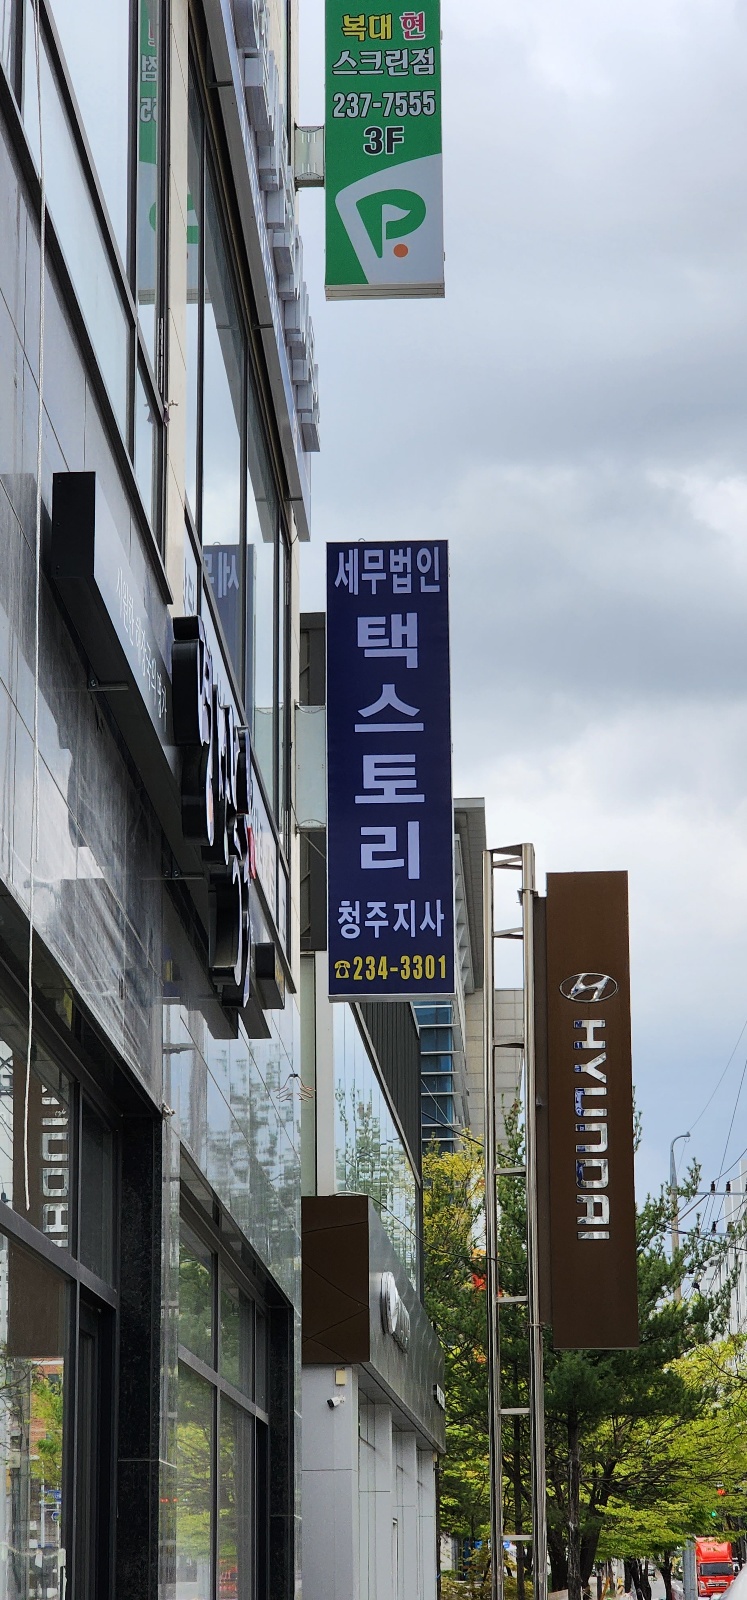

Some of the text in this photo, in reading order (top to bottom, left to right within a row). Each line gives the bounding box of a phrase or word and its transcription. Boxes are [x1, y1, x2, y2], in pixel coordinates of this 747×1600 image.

[342, 11, 426, 41] 복대 현
[332, 47, 435, 76] 스크린점
[332, 90, 436, 118] 237-7555
[363, 126, 404, 155] 3F
[334, 547, 440, 595] 세무법인
[354, 612, 425, 879] 택스토리
[337, 900, 445, 939] 청주지사
[353, 954, 446, 980] 234-3301
[573, 1019, 610, 1240] HYUNDAI
